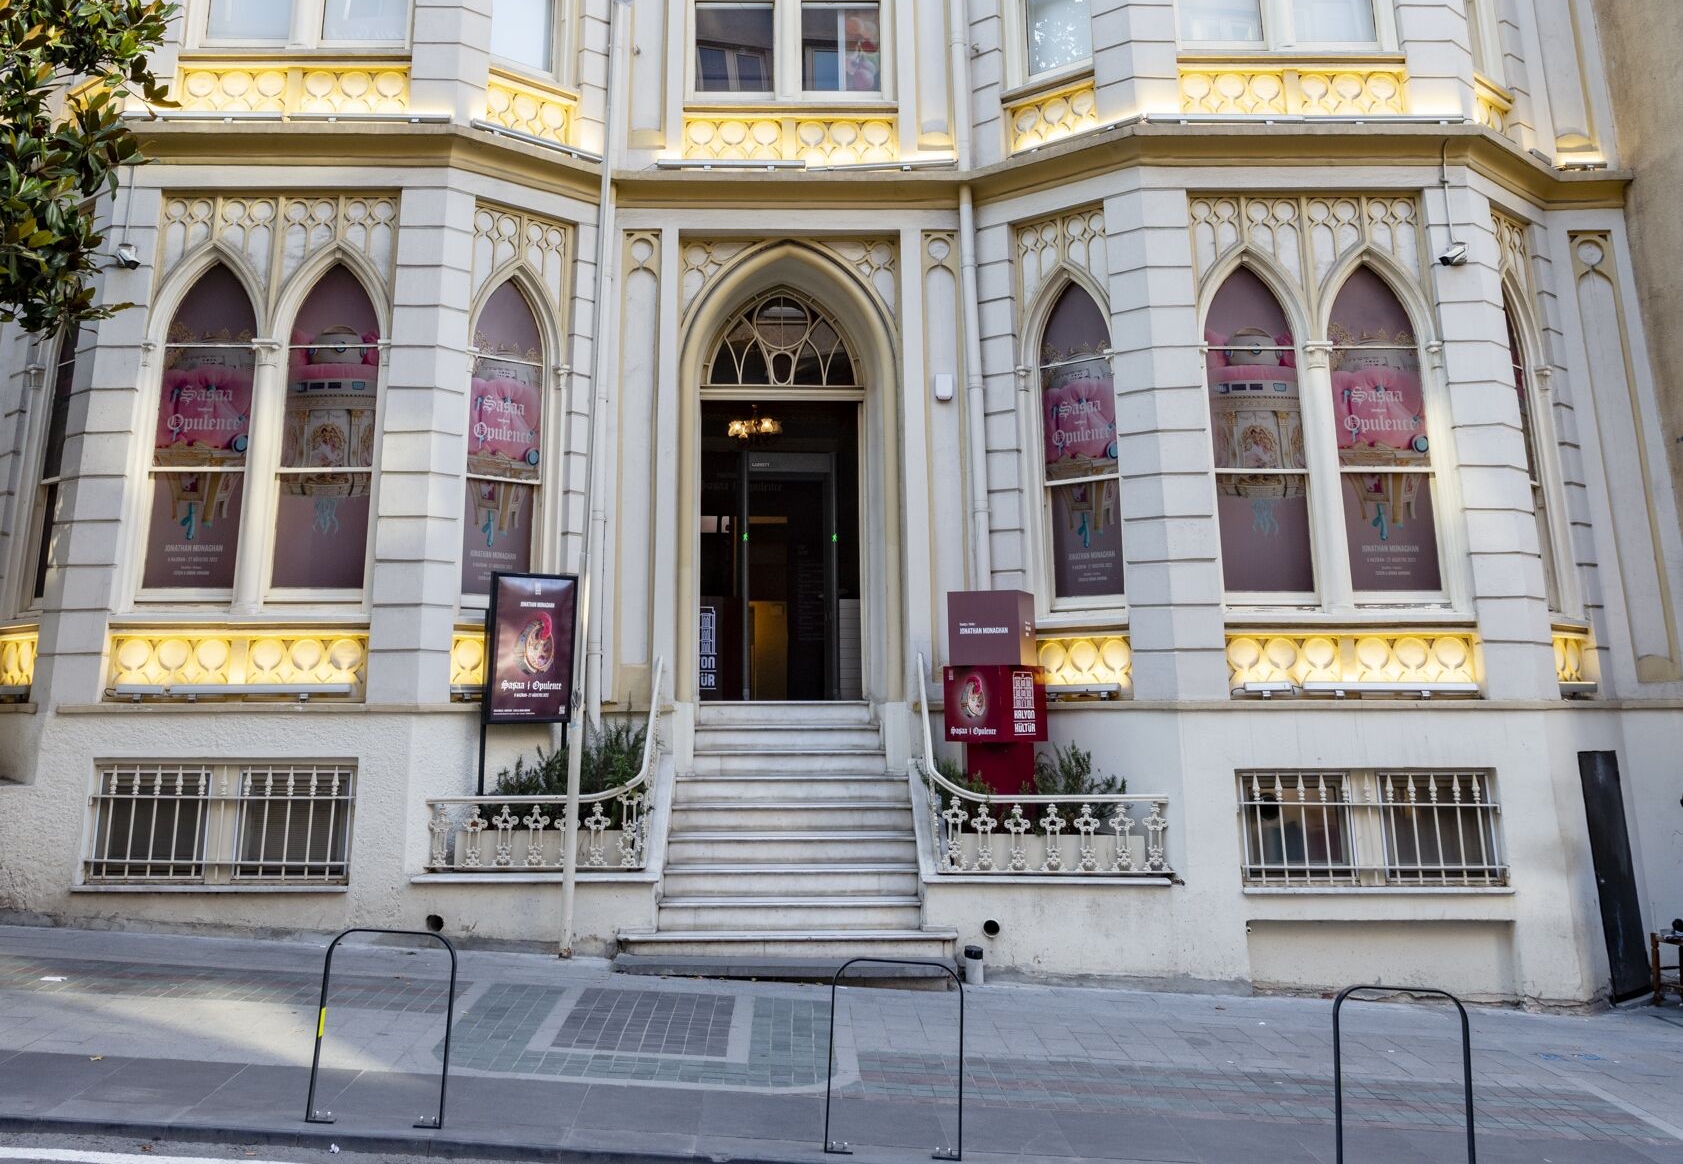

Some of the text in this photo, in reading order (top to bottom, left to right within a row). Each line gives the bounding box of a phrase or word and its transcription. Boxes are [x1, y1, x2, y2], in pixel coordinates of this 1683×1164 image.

[167, 413, 242, 433] Opulence
[1344, 414, 1417, 433] Opulence
[473, 422, 534, 444] Opulence
[1052, 427, 1111, 447] Opulence
[959, 627, 982, 635] JONATHAN
[532, 681, 562, 691] Opulence
[1014, 710, 1035, 719] KALYON
[973, 726, 997, 735] Opulence
[1014, 723, 1036, 733] KÜLTÜR
